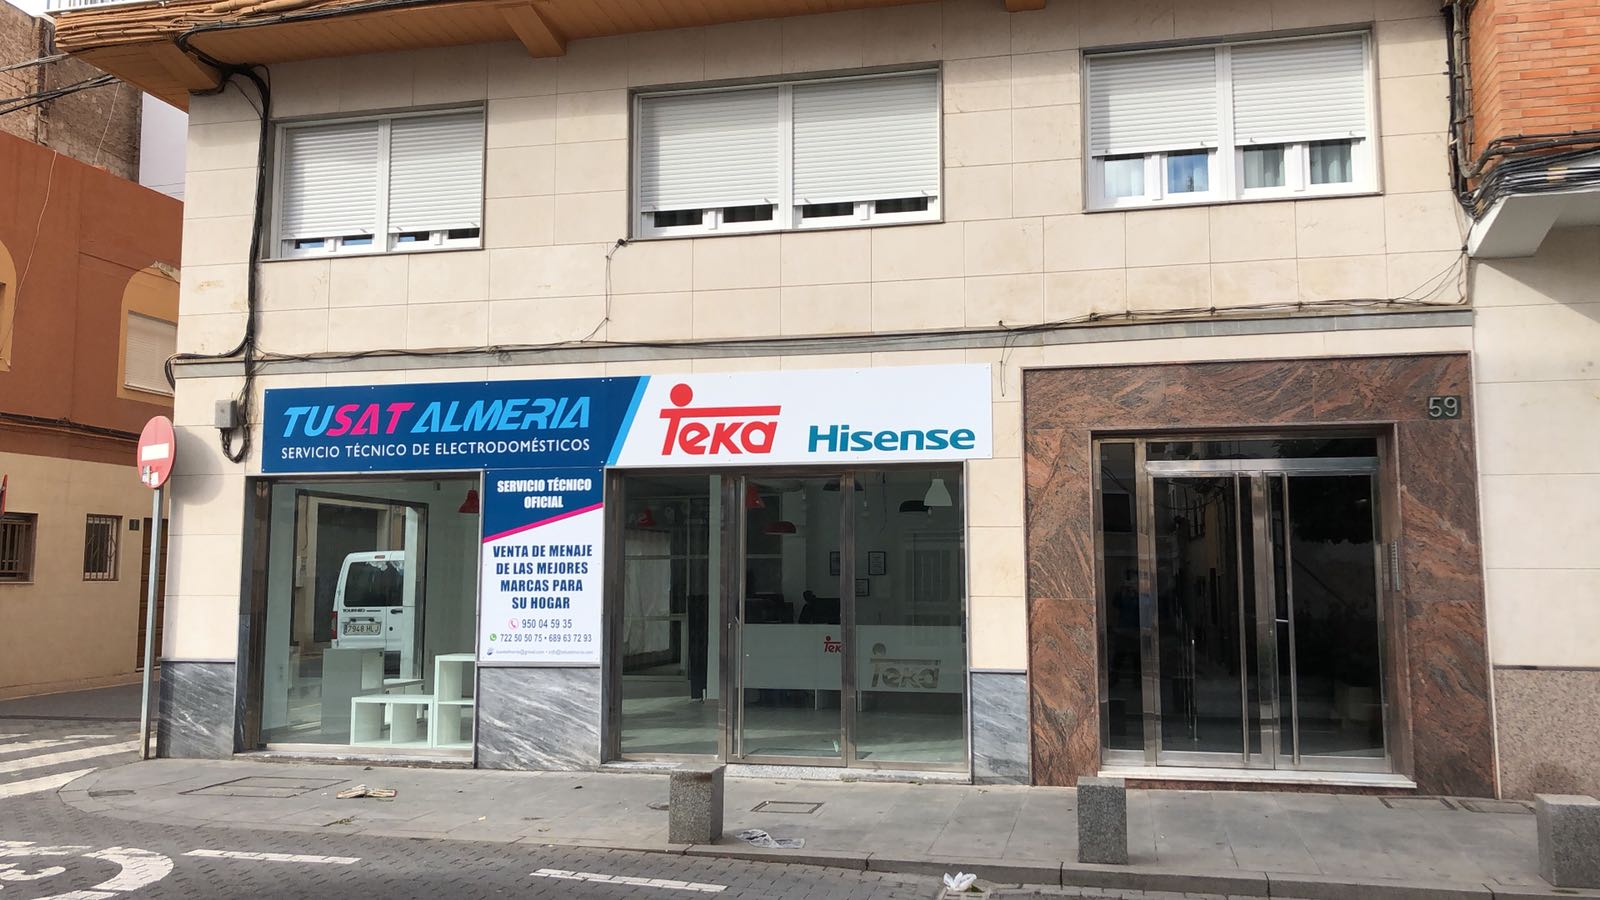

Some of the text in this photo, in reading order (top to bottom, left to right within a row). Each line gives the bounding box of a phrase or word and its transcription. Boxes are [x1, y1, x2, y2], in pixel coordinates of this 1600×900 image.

[1429, 396, 1458, 418] 59
[410, 396, 591, 433] ALMERIA
[807, 424, 976, 453] Hisense
[281, 437, 591, 459] SERVICIO TÉCNICO DE ELECTRODOMÉSTICOS
[497, 477, 592, 493] SERVICIO TÉCNICO
[524, 496, 564, 509] OFICIAL
[493, 544, 593, 557] VENTA DE MENAJE
[496, 562, 588, 575] DE LAS MEJORES
[500, 579, 583, 592] MARCAS PARA
[512, 596, 570, 609] SU HOGAR
[522, 619, 572, 628] 950 04 59 35
[500, 634, 512, 642] 722
[514, 634, 522, 642] 50
[524, 634, 532, 642] 50
[534, 634, 542, 642] 75
[563, 634, 571, 642] 63
[573, 634, 581, 642] 72
[583, 634, 592, 642] 93
[824, 635, 842, 653] Tek
